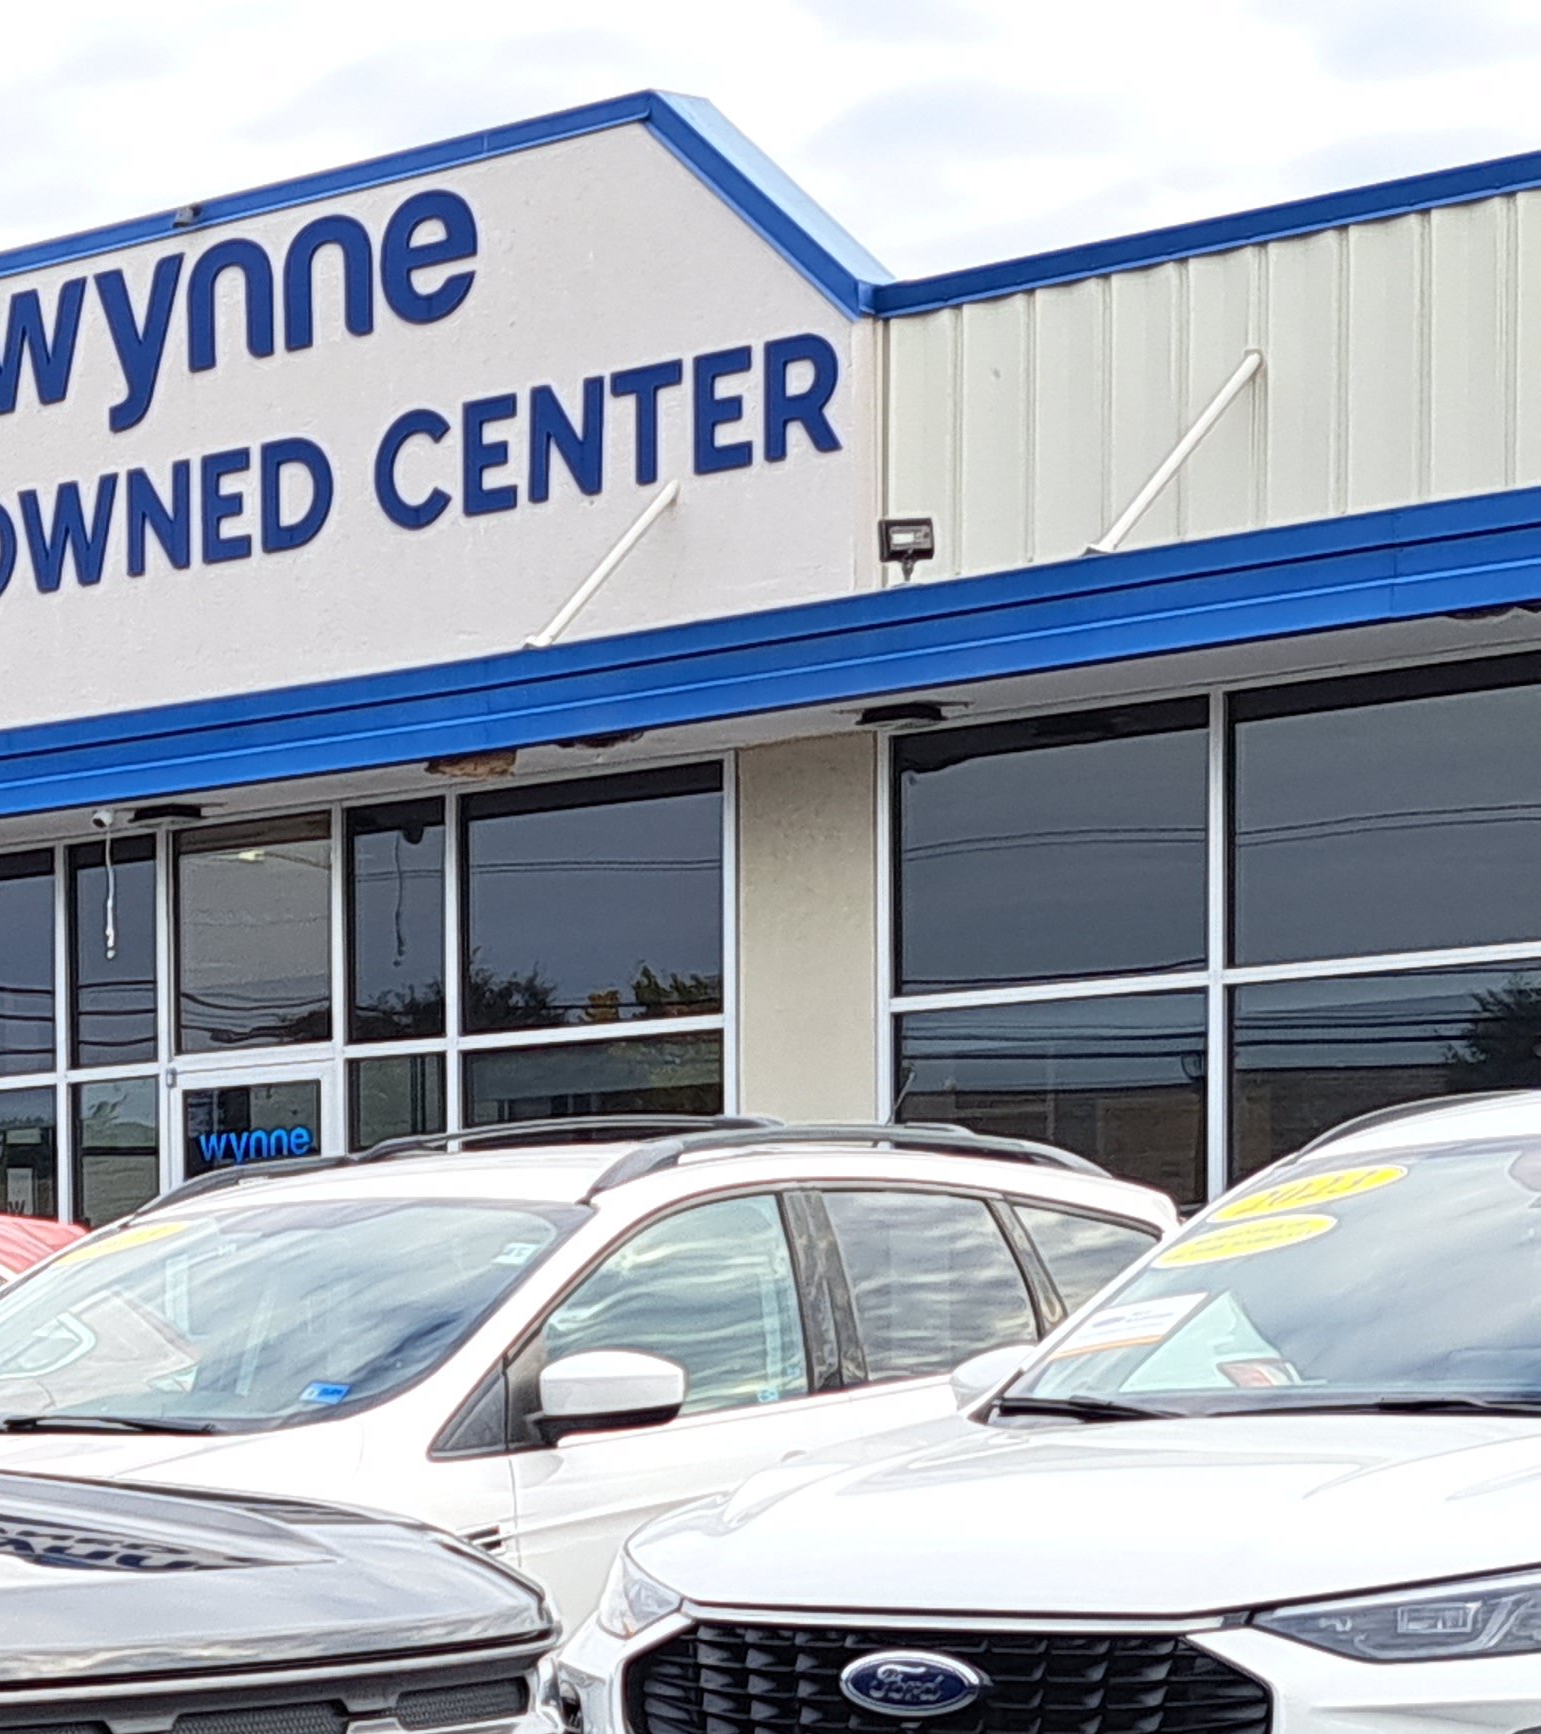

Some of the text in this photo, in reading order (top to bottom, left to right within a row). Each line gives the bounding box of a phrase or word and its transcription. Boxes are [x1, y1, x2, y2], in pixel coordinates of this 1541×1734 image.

[375, 333, 840, 530] CENTER
[199, 1126, 311, 1165] wynne
[869, 1664, 944, 1700] Ford
